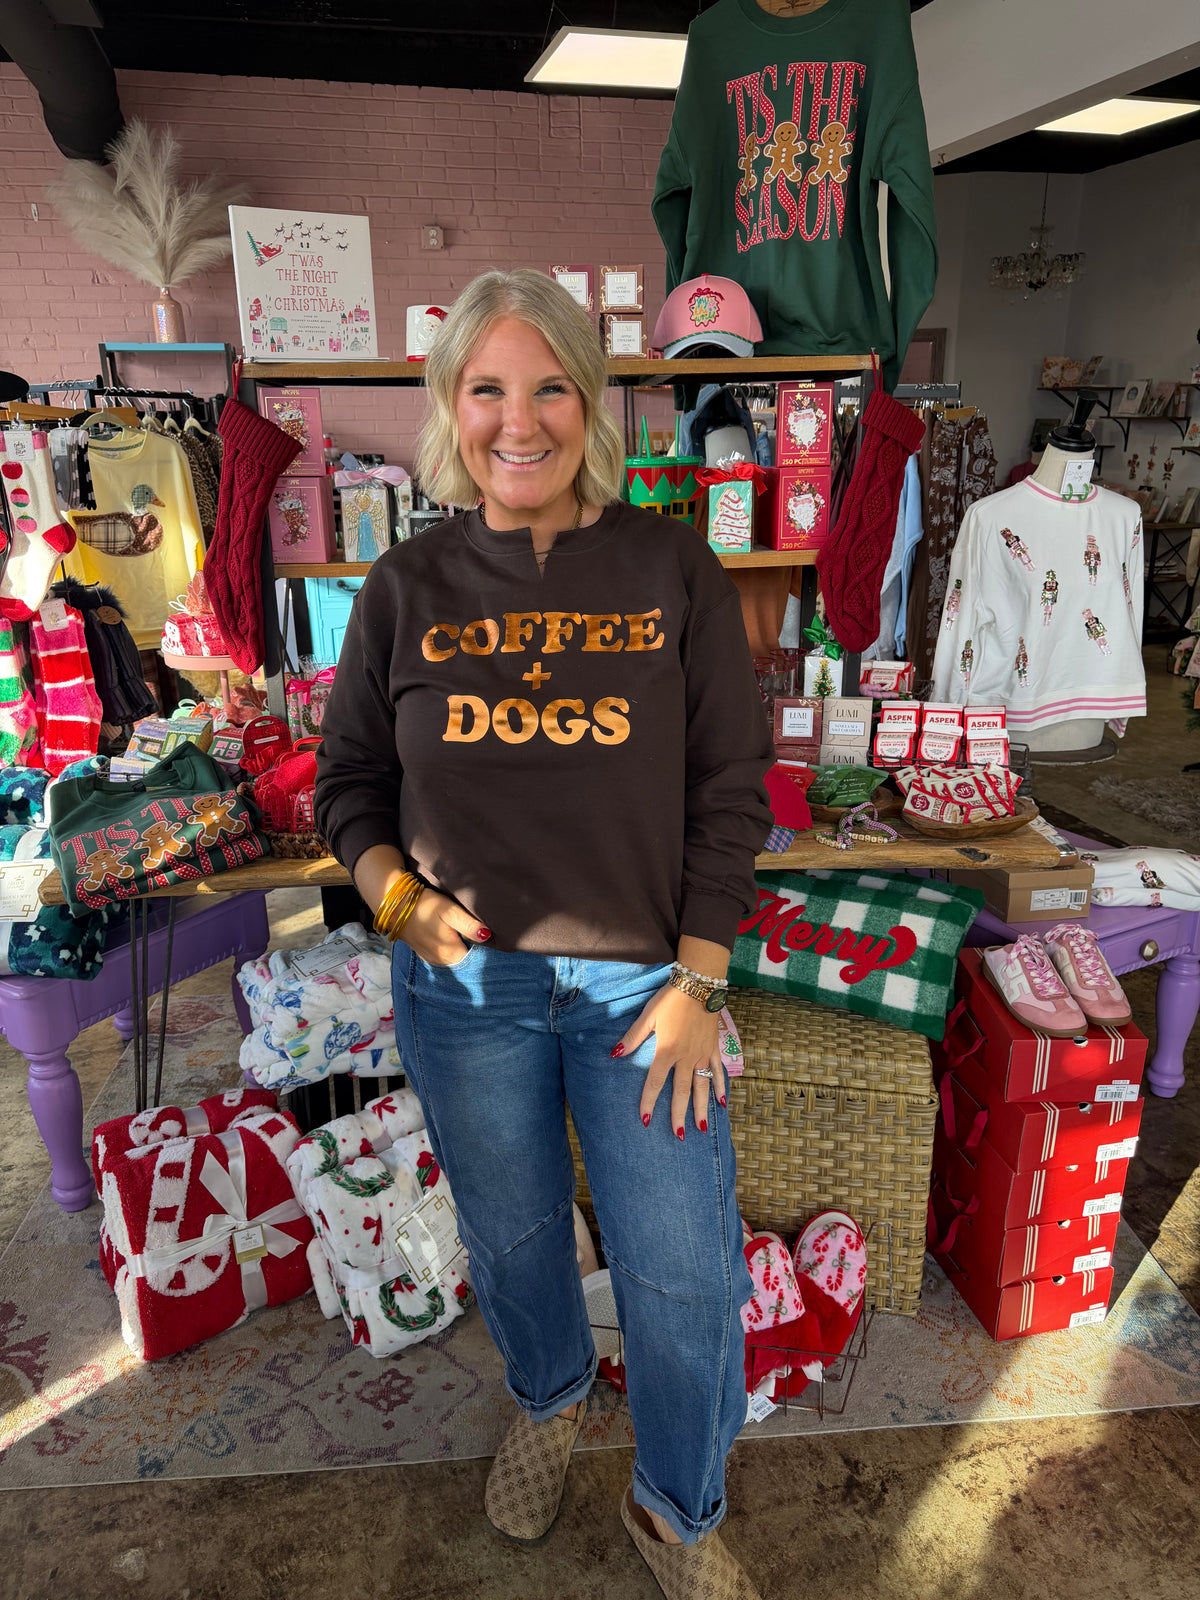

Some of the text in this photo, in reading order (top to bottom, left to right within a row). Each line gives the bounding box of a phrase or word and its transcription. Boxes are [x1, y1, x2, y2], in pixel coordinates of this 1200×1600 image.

[786, 62, 867, 142] THE
[275, 268, 338, 284] THE NIGHT
[290, 285, 328, 297] BEFORE
[274, 297, 345, 312] CHRISTMAS
[421, 608, 665, 662] COFFEE
[522, 662, 552, 690] +
[442, 695, 631, 745] DOGS
[789, 711, 807, 719] LUMI
[836, 709, 859, 718] LUMI
[832, 755, 855, 764] LUMI
[61, 819, 139, 868] TIS
[737, 888, 917, 984] Merry
